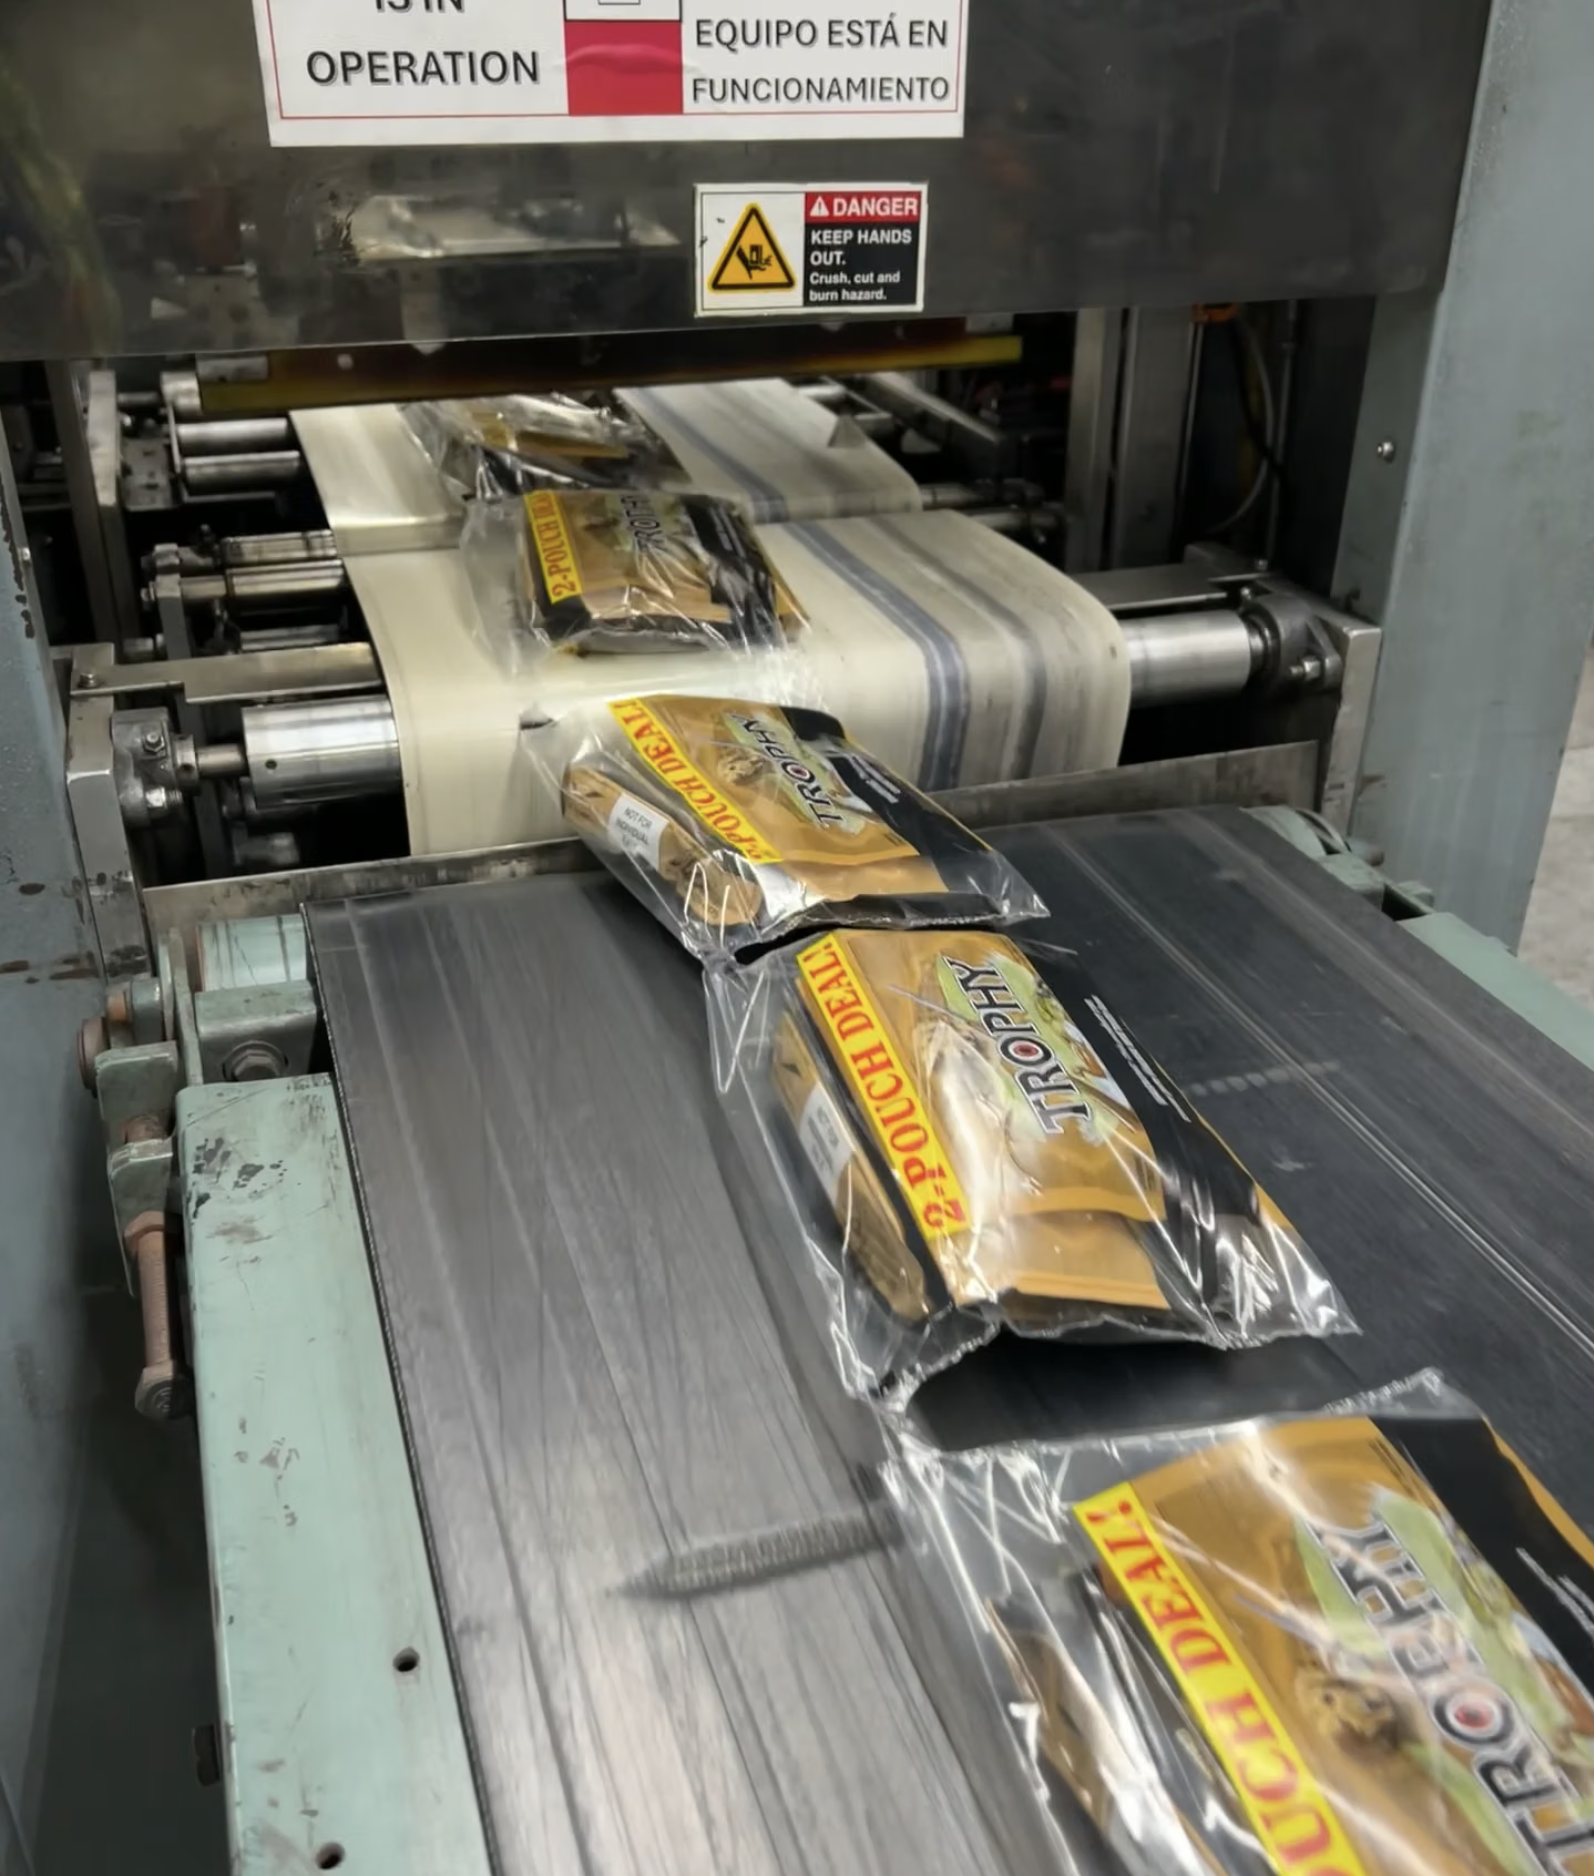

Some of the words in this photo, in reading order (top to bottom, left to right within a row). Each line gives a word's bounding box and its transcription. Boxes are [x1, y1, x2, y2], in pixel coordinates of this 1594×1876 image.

[695, 18, 818, 54] EQUIPO
[828, 12, 899, 47] ESTÁ
[909, 20, 948, 47] EN
[306, 50, 540, 85] OPERATION
[692, 77, 950, 103] FUNCIONAMIENTO
[833, 197, 918, 217] DANGER
[811, 230, 853, 245] KEEP
[857, 229, 912, 244] HANDS
[810, 251, 846, 266] OUT.
[809, 272, 851, 286] Crush,
[854, 273, 874, 284] cut
[877, 271, 900, 283] and
[809, 289, 838, 302] burn
[841, 288, 887, 300] hazard.
[731, 713, 843, 829] TROPHY
[802, 942, 875, 1041] DEAL!
[941, 955, 1092, 1134] TROPHY
[851, 1040, 966, 1229] 2-POUCH
[1086, 1500, 1233, 1674] DEAL!
